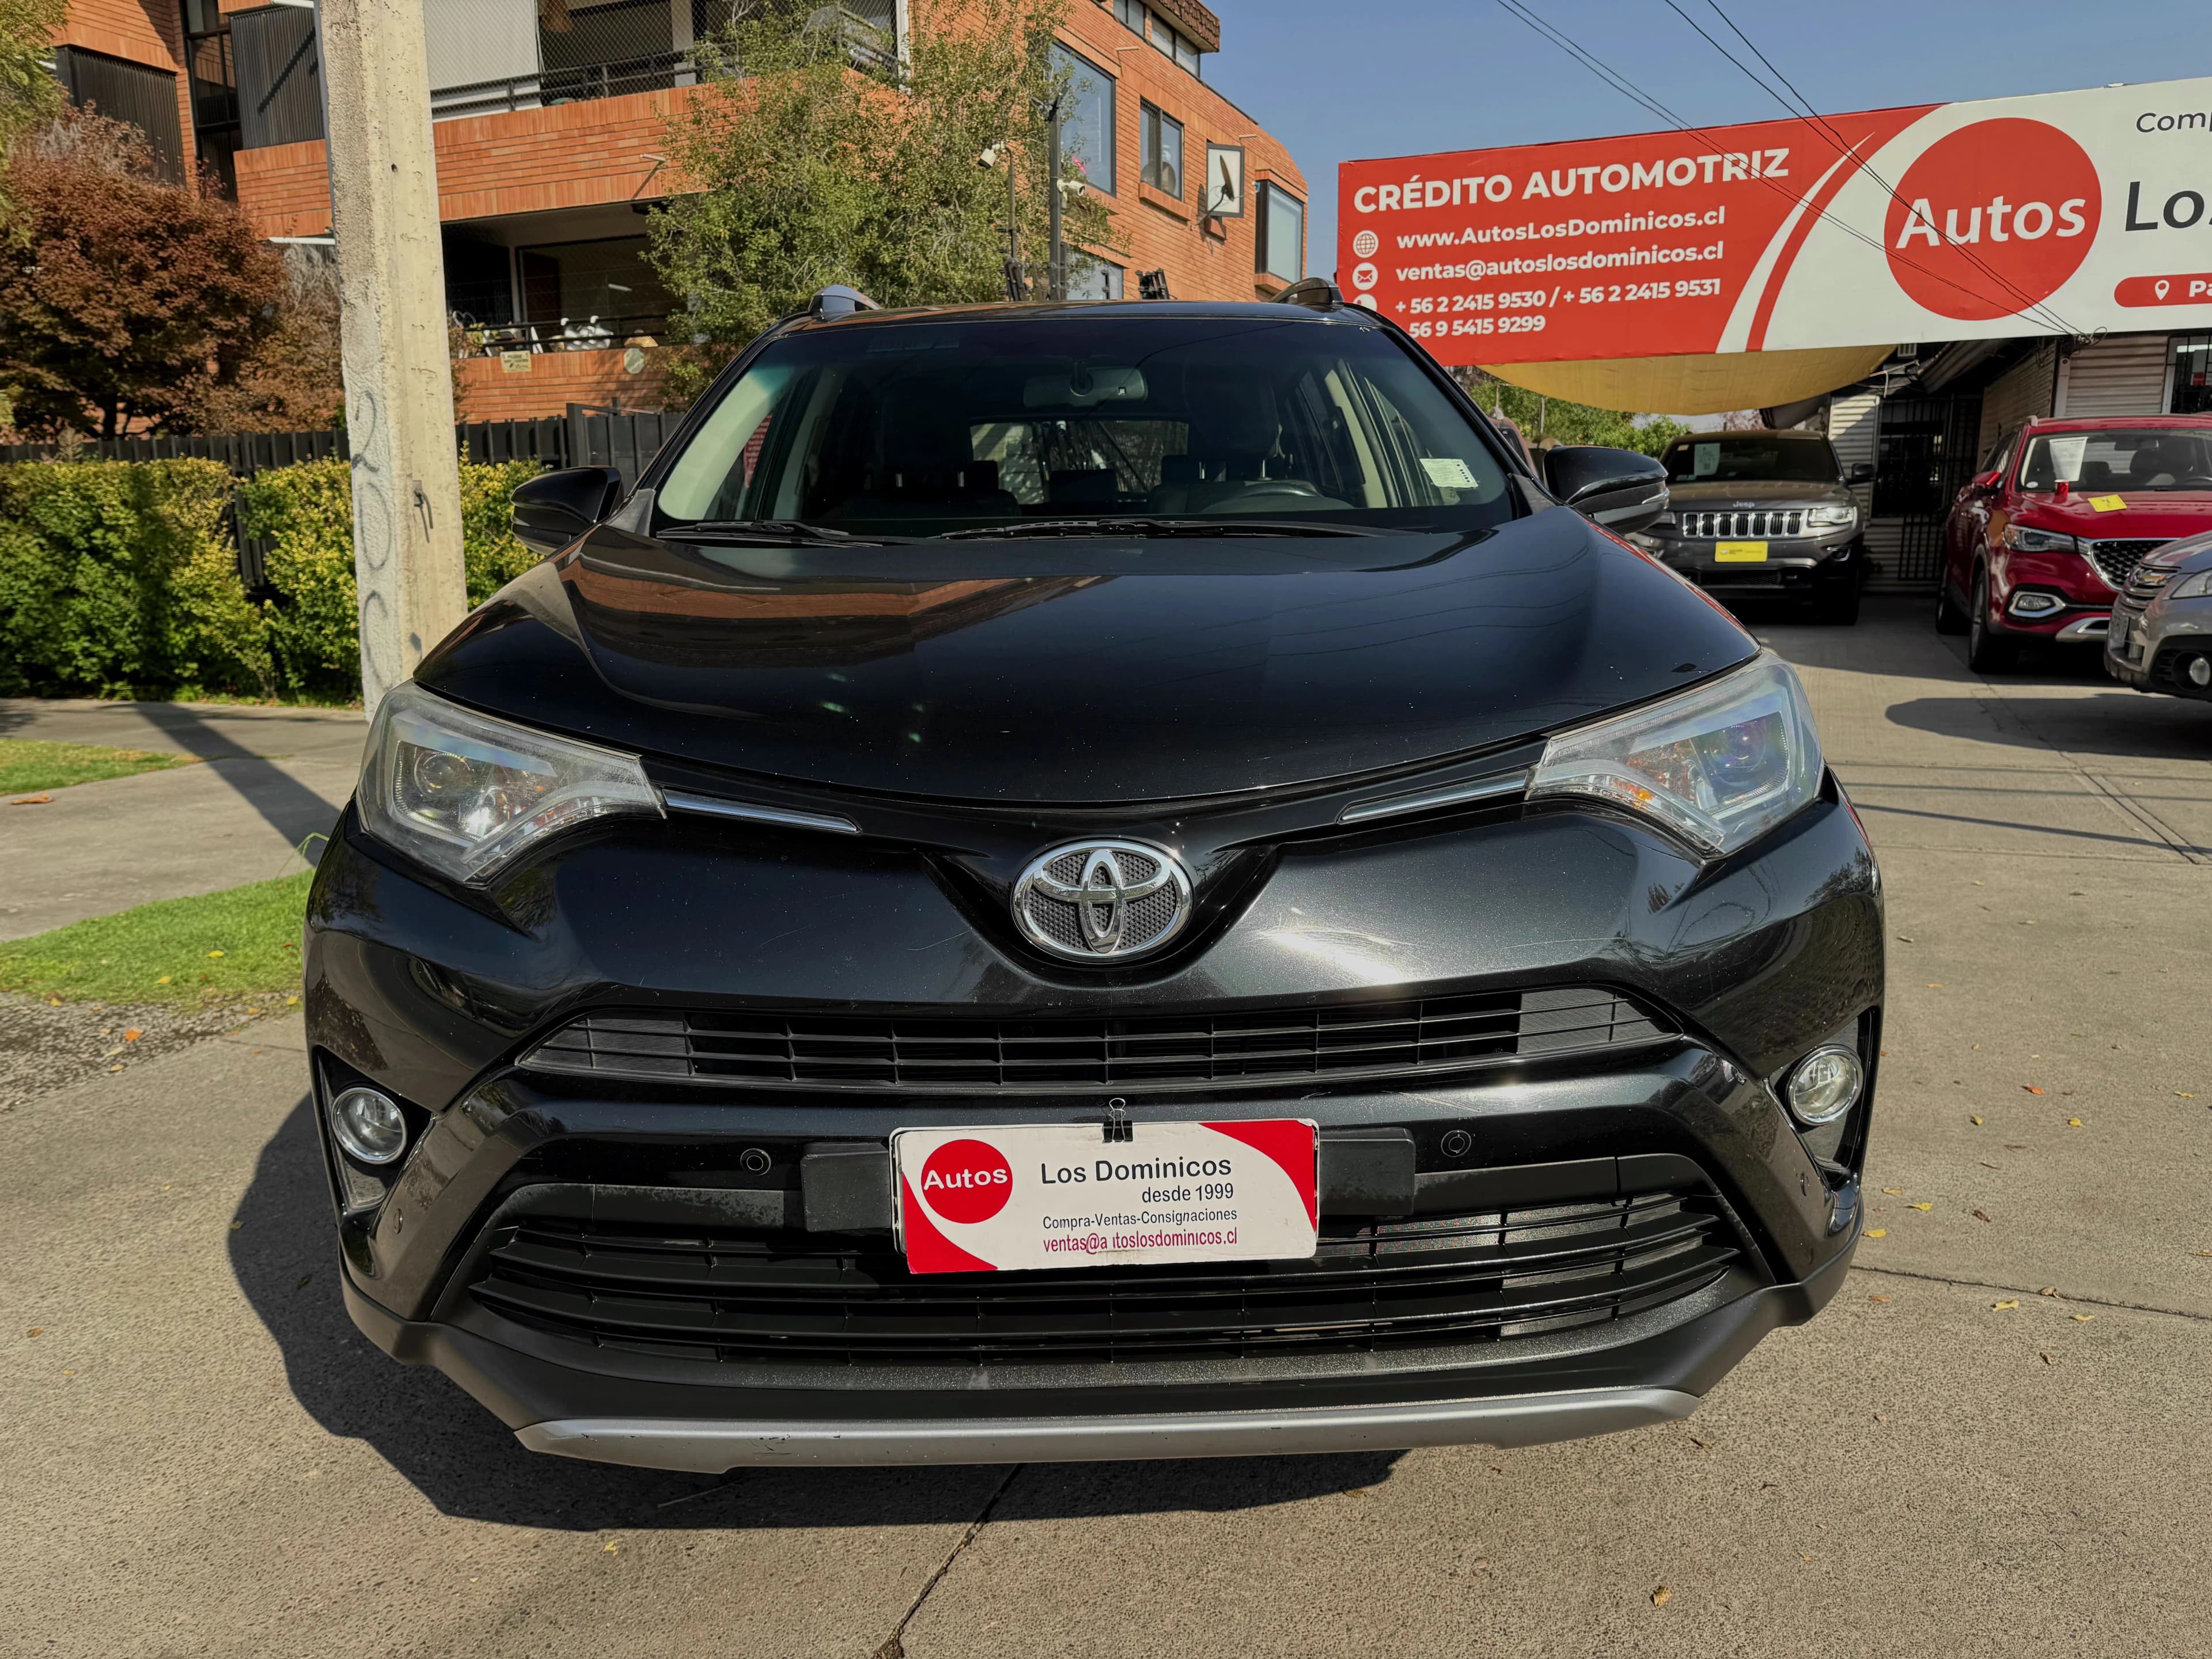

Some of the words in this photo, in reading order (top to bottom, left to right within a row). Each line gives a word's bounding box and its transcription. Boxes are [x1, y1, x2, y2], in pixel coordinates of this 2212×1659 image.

[2136, 112, 2212, 132] Com
[1354, 175, 1513, 213] CRÉDITO
[1522, 147, 1790, 200] AUTOMOTRIZ
[1895, 195, 2086, 249] Autos
[2125, 181, 2212, 232] Lo
[1396, 205, 1725, 249] www.AutosLosDominicos.cl
[1395, 240, 1724, 282] ventas@autoslosdominicos.cl
[1395, 301, 1406, 312] +
[1410, 297, 1434, 314] 56
[1437, 296, 1449, 313] 2
[1452, 293, 1495, 312] 2415
[1498, 290, 1547, 309] 9530
[1548, 286, 1560, 308] /
[1563, 290, 1575, 302] +
[1579, 286, 1605, 304] 56
[1608, 285, 1621, 302] 2
[1624, 282, 1671, 301] 2415
[1675, 278, 1721, 297] 9531
[1408, 321, 1432, 340] 56
[1435, 320, 1448, 337] 9
[1451, 317, 1494, 336] 5415
[1497, 315, 1546, 334] 9299
[923, 1166, 1008, 1191] Autos
[1041, 1163, 1086, 1184] Los
[1096, 1156, 1232, 1181] Dominicos
[1142, 1185, 1191, 1203] desde
[1195, 1183, 1234, 1202] 1999
[1043, 1209, 1237, 1231] Compra-Ventas-Consignaciones
